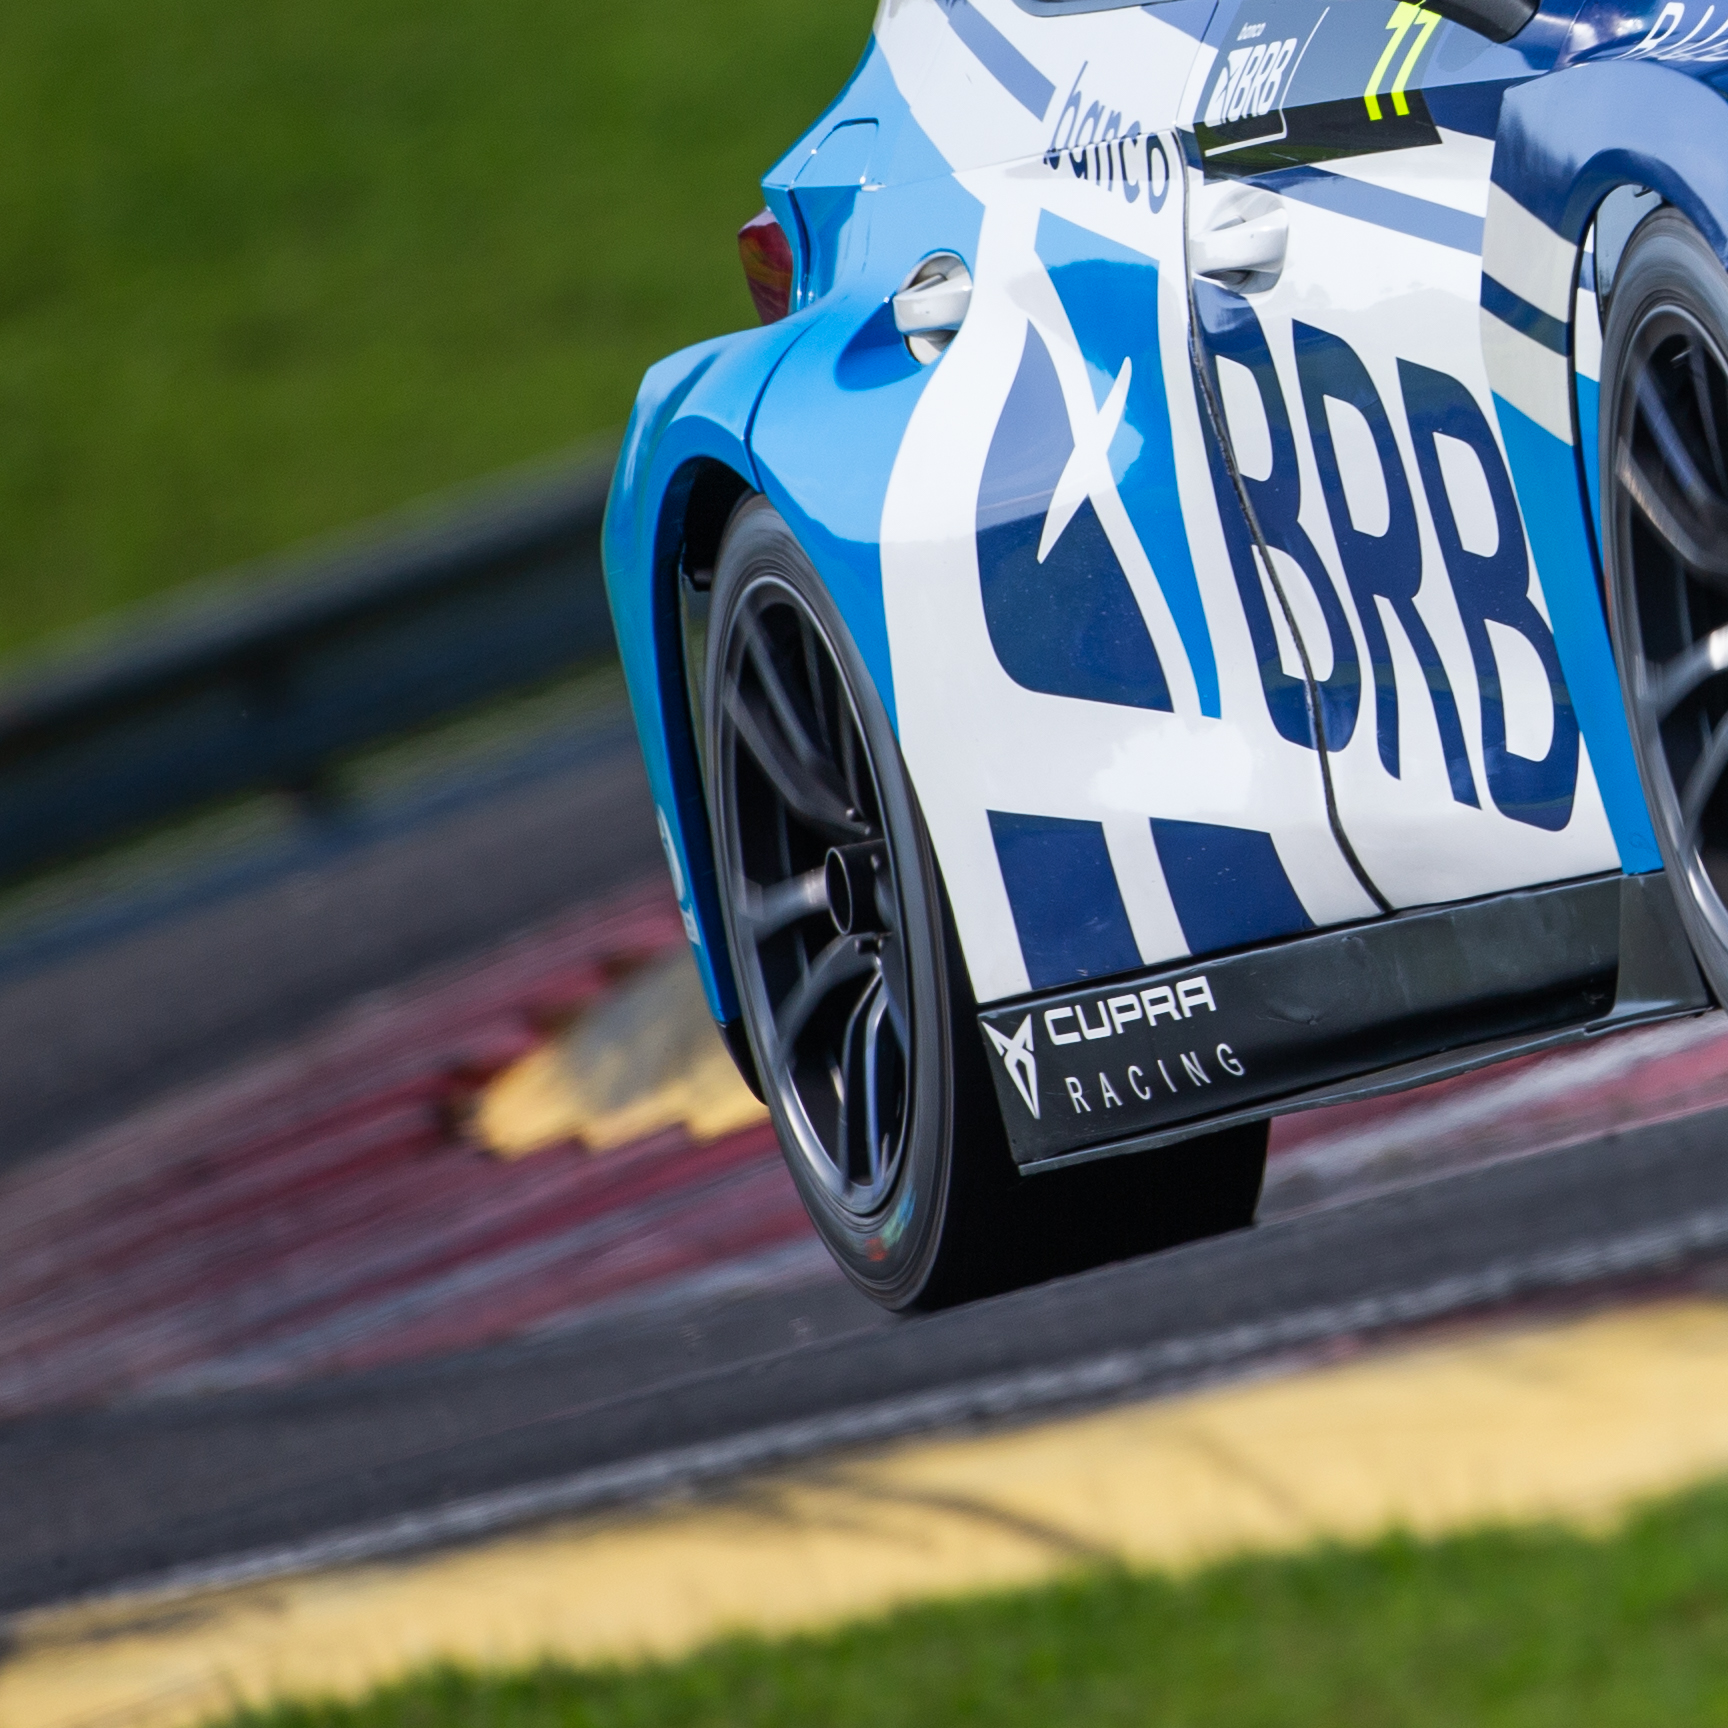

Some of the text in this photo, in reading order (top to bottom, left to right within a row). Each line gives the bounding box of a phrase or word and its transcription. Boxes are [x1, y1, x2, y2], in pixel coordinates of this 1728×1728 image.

[1236, 22, 1267, 42] banco
[1363, 0, 1442, 122] 77
[1226, 37, 1298, 123] BRB
[1043, 60, 1171, 215] banco
[1188, 276, 1581, 833] BRB
[1044, 975, 1217, 1046] CUPRA
[1064, 1043, 1246, 1114] RACING
